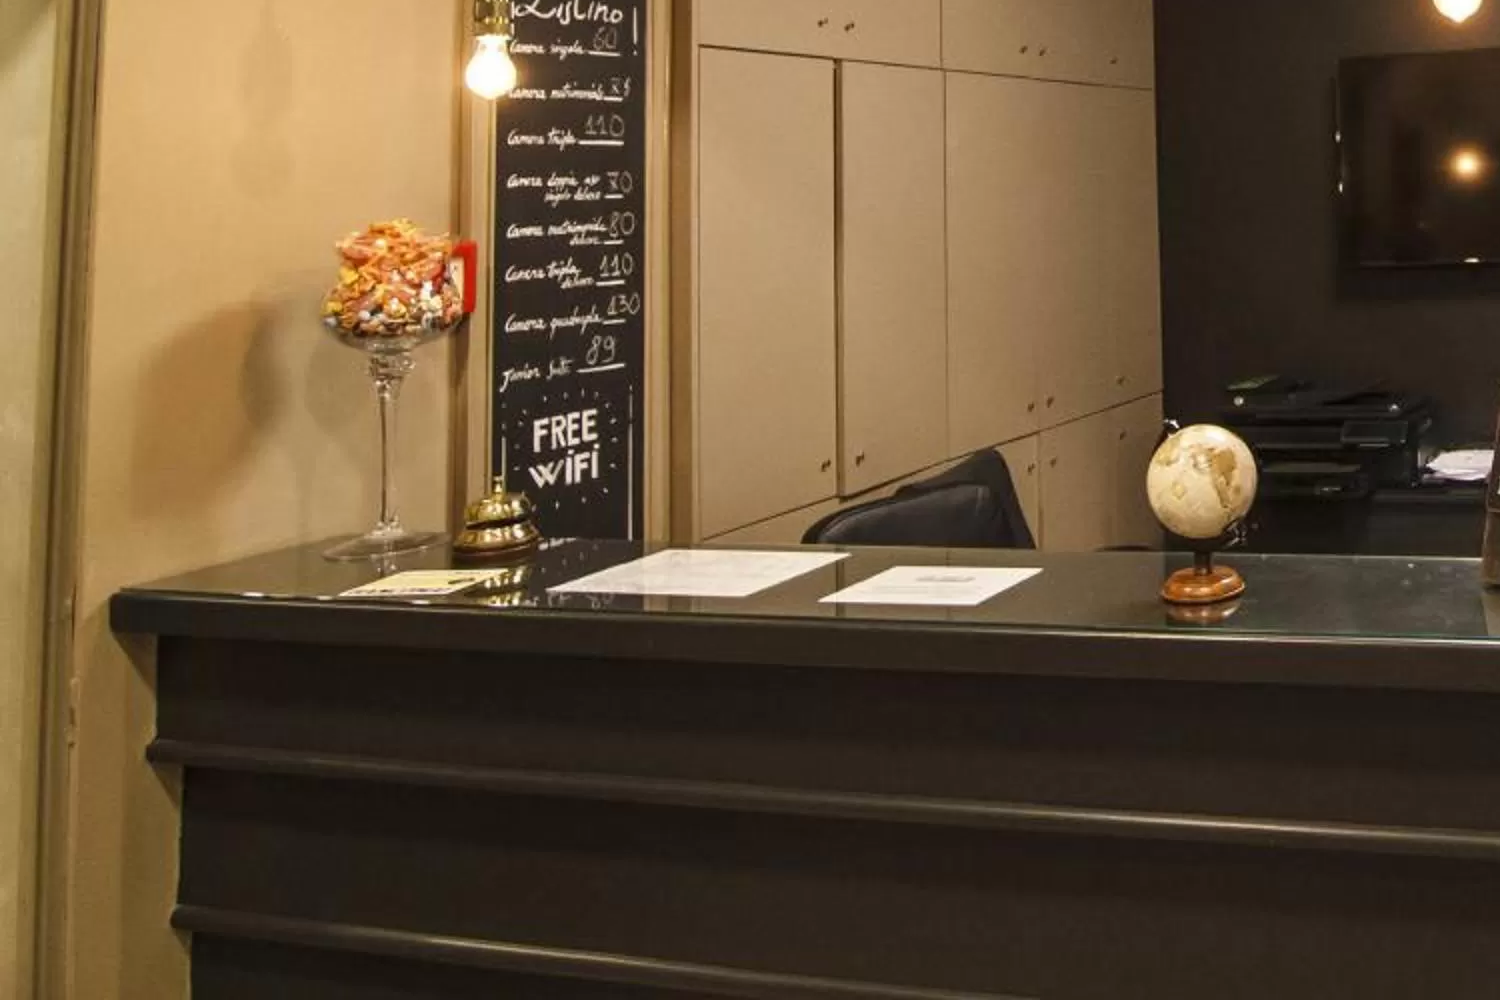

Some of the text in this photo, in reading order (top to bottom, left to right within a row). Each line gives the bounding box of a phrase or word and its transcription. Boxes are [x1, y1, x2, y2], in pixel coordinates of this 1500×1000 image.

[585, 113, 625, 137] 110
[600, 252, 633, 277] 110
[607, 292, 641, 316] 130
[586, 335, 616, 366] 89
[533, 408, 599, 453] FREE
